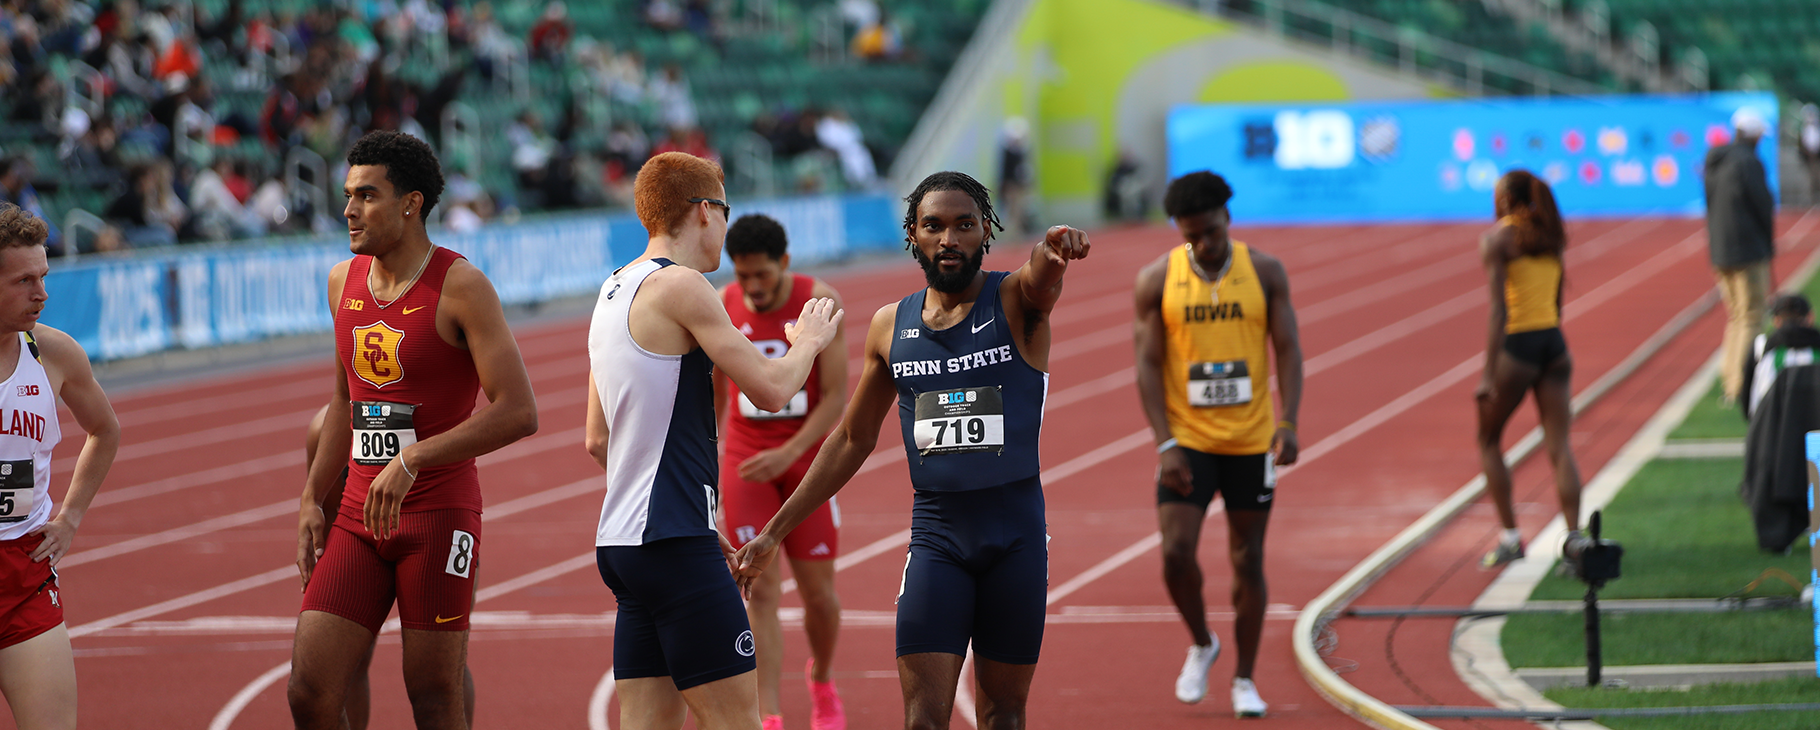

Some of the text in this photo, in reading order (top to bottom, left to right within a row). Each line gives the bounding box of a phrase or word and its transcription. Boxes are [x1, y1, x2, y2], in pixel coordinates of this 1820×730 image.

[1185, 303, 1243, 321] IOWA
[892, 344, 1012, 379] PENN STATE
[361, 432, 400, 458] 809
[932, 417, 985, 446] 719
[453, 534, 470, 574] 8
